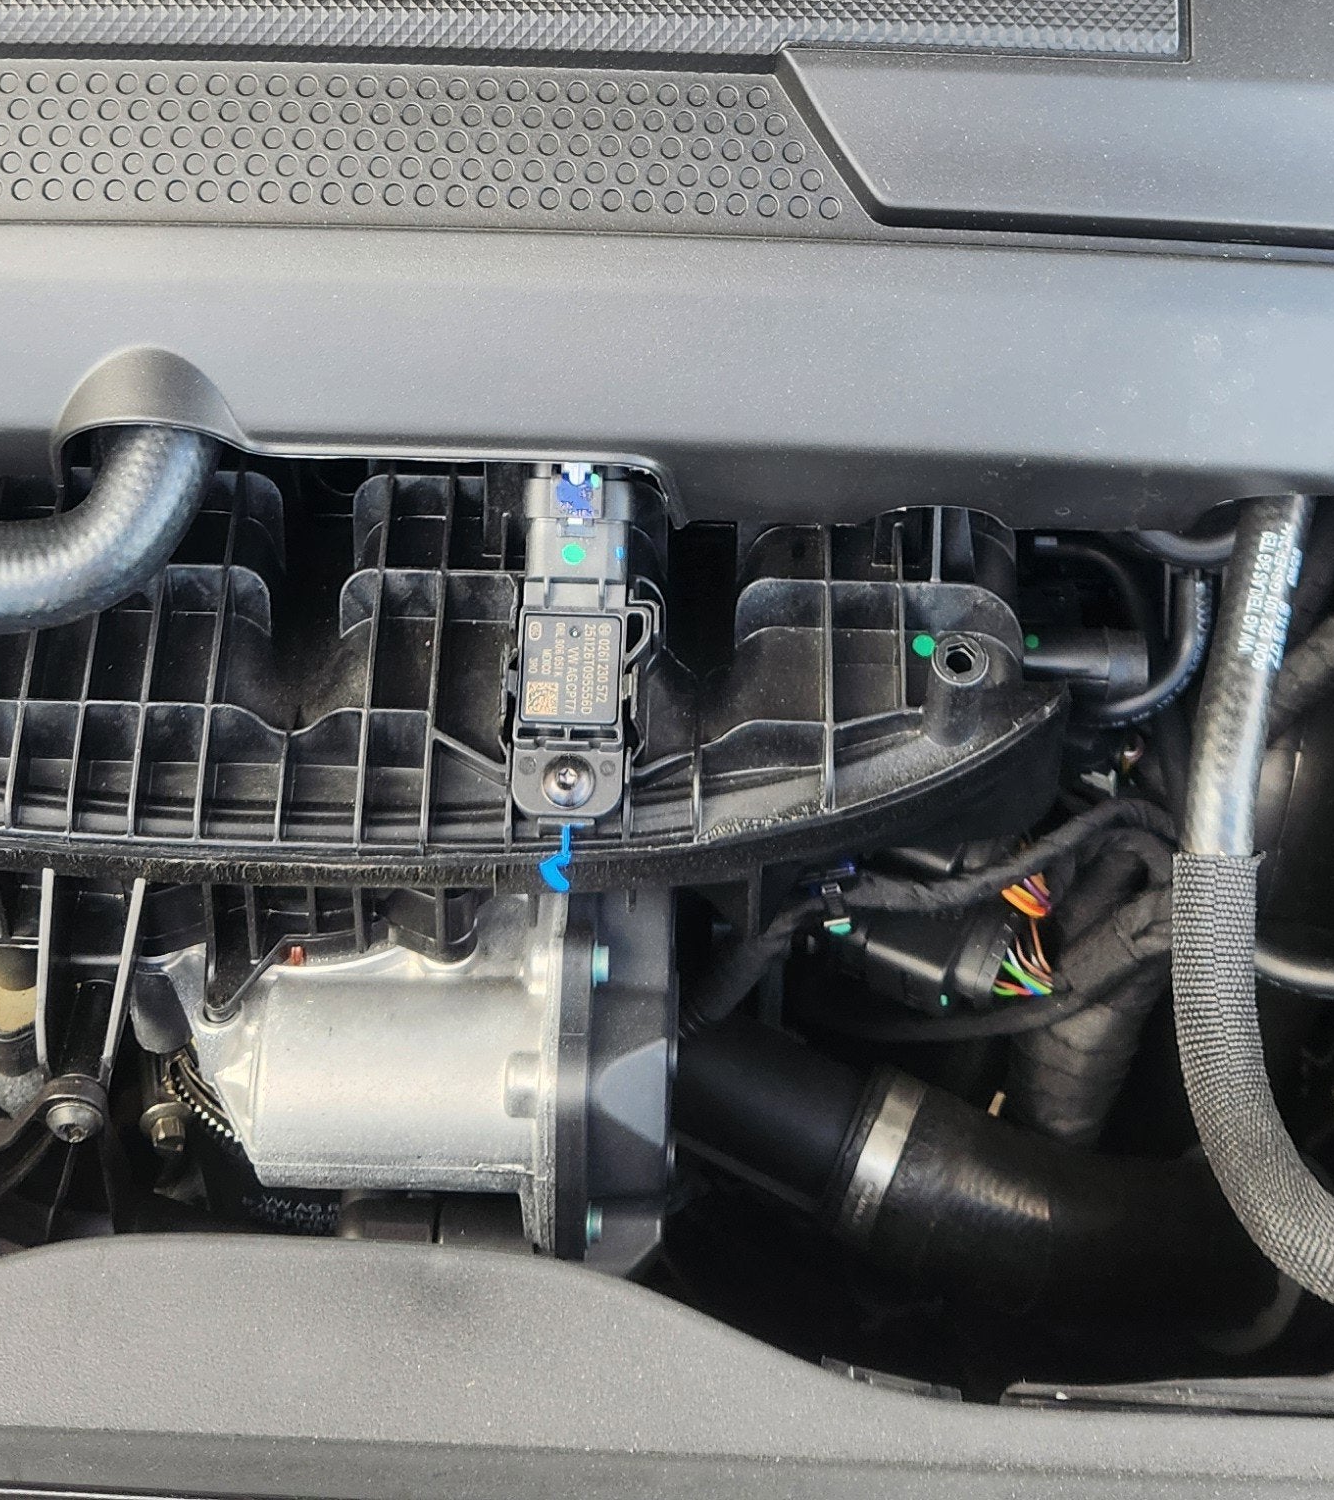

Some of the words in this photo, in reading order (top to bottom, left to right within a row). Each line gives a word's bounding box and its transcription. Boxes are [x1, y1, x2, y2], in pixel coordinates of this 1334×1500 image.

[1262, 595, 1279, 615] 101
[1240, 613, 1259, 633] AG
[1257, 617, 1274, 638] 122
[597, 638, 609, 661] 0261
[1236, 631, 1255, 655] VW
[567, 646, 578, 663] VW
[597, 664, 608, 682] 230
[596, 685, 607, 702] 572
